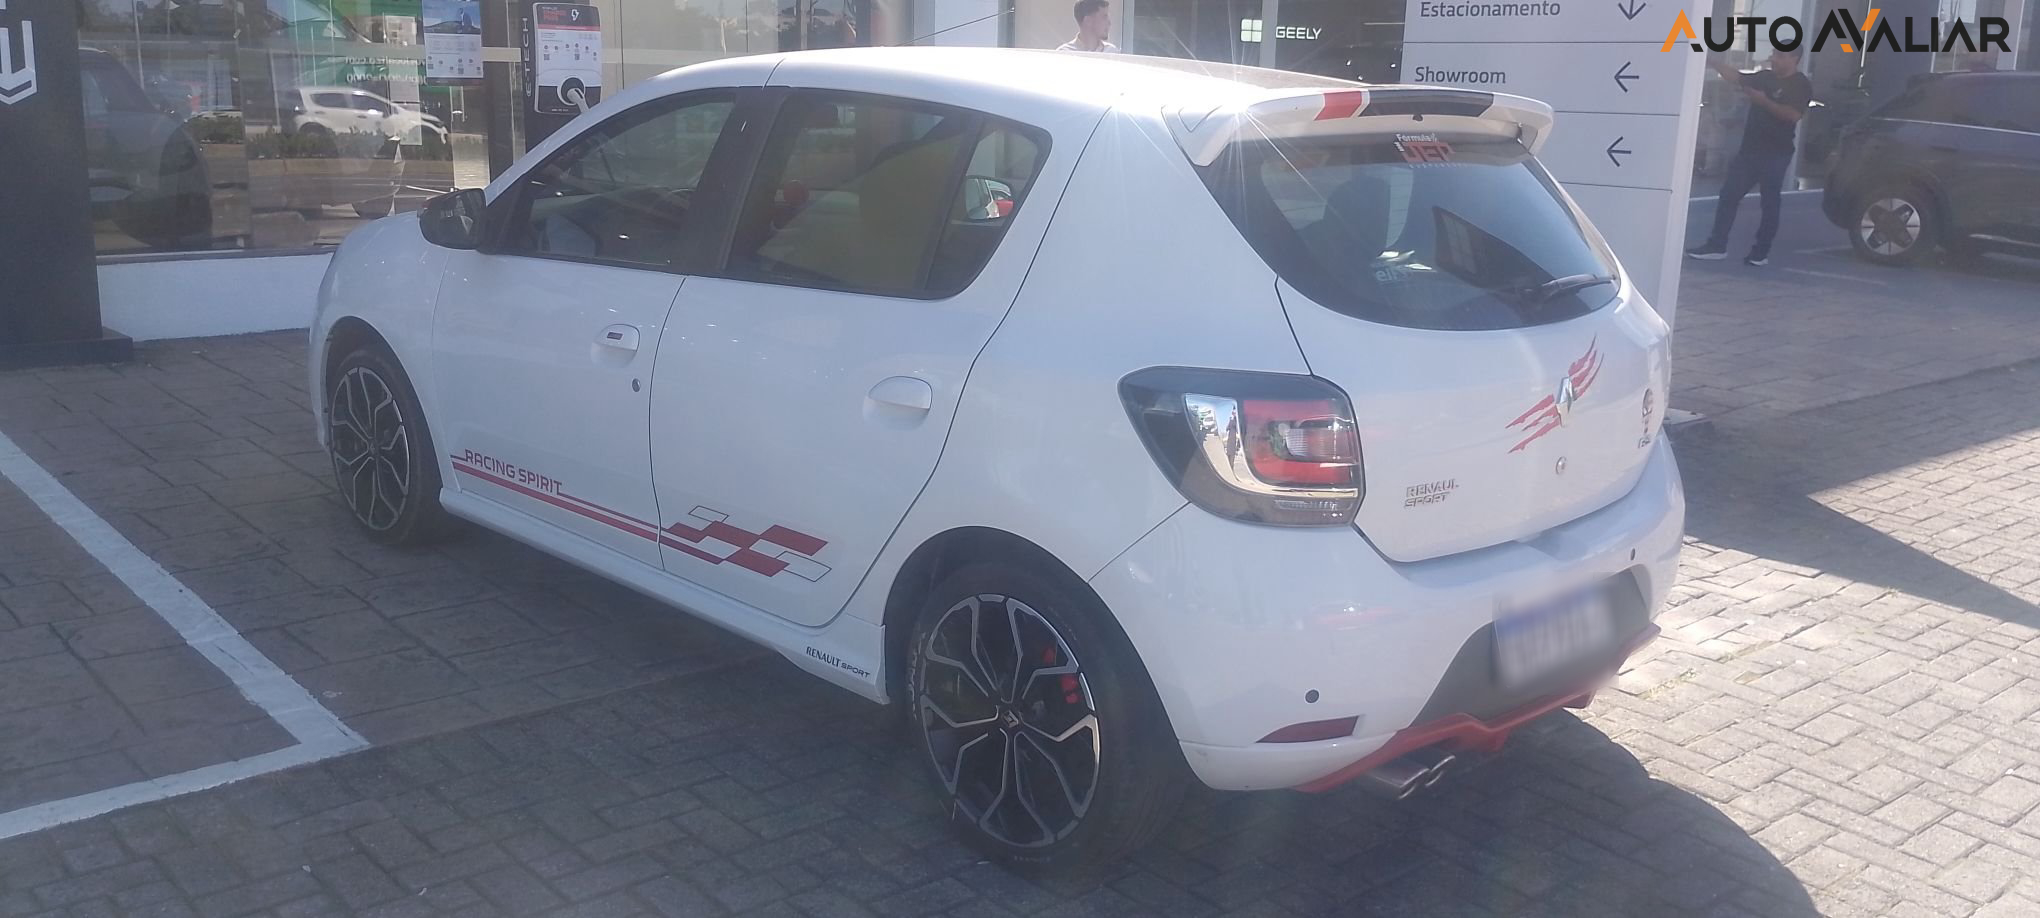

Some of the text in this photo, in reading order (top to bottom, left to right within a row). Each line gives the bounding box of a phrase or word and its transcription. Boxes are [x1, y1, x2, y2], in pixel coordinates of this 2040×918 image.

[1420, 0, 1561, 18] Estacionamento
[1275, 26, 1322, 40] GEELY
[1415, 66, 1506, 84] Showroom
[465, 449, 562, 496] RACING SPIRIT
[1406, 478, 1461, 498] RENAUL
[1404, 491, 1450, 508] SPORT
[806, 645, 871, 678] RENAULT SPORT
